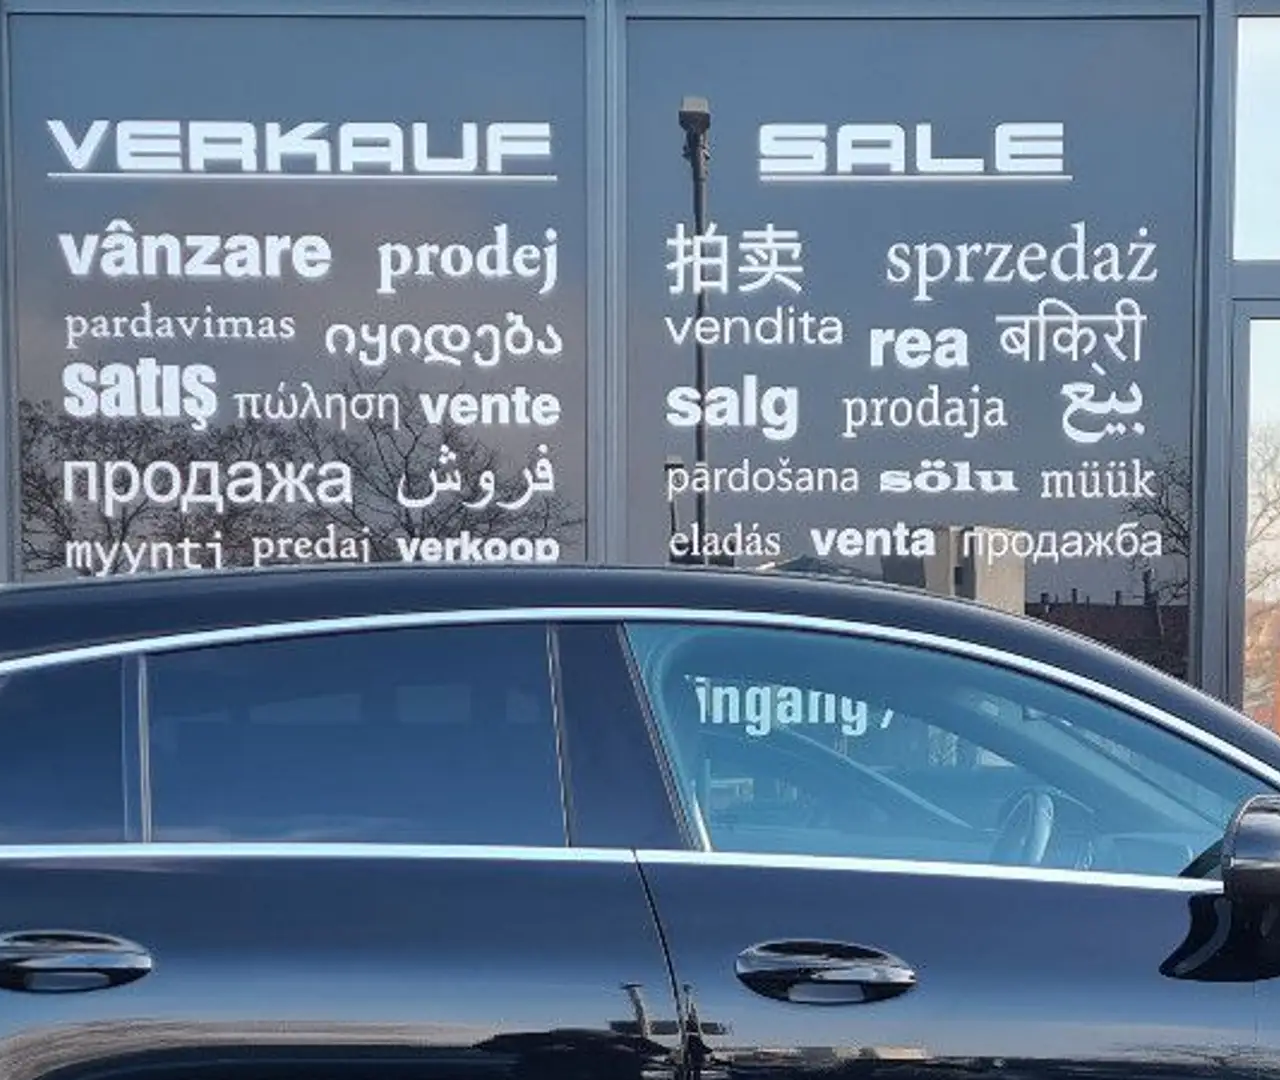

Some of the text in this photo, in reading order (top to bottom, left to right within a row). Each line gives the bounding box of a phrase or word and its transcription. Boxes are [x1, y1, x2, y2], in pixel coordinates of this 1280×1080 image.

[47, 120, 551, 172] VERKAUF
[759, 123, 1065, 173] SALE
[59, 219, 558, 294] vânzare prodej
[665, 222, 803, 294] 拍卖
[885, 221, 1158, 301] sprzedaż
[65, 301, 296, 349] pardavimas
[325, 312, 563, 366] იყიდება
[665, 306, 968, 367] vendita rea
[62, 357, 217, 431] satış
[233, 382, 400, 430] πώληση
[419, 386, 561, 425] vente
[666, 374, 1008, 440] salg prodaja
[63, 460, 353, 516] продажа
[880, 459, 1019, 493] sölu
[1041, 459, 1157, 498] müük
[66, 531, 222, 577] myynti
[251, 524, 370, 567] predaj
[670, 521, 937, 557] eladás venta
[964, 523, 1161, 565] продажба
[685, 674, 868, 736] ingang
